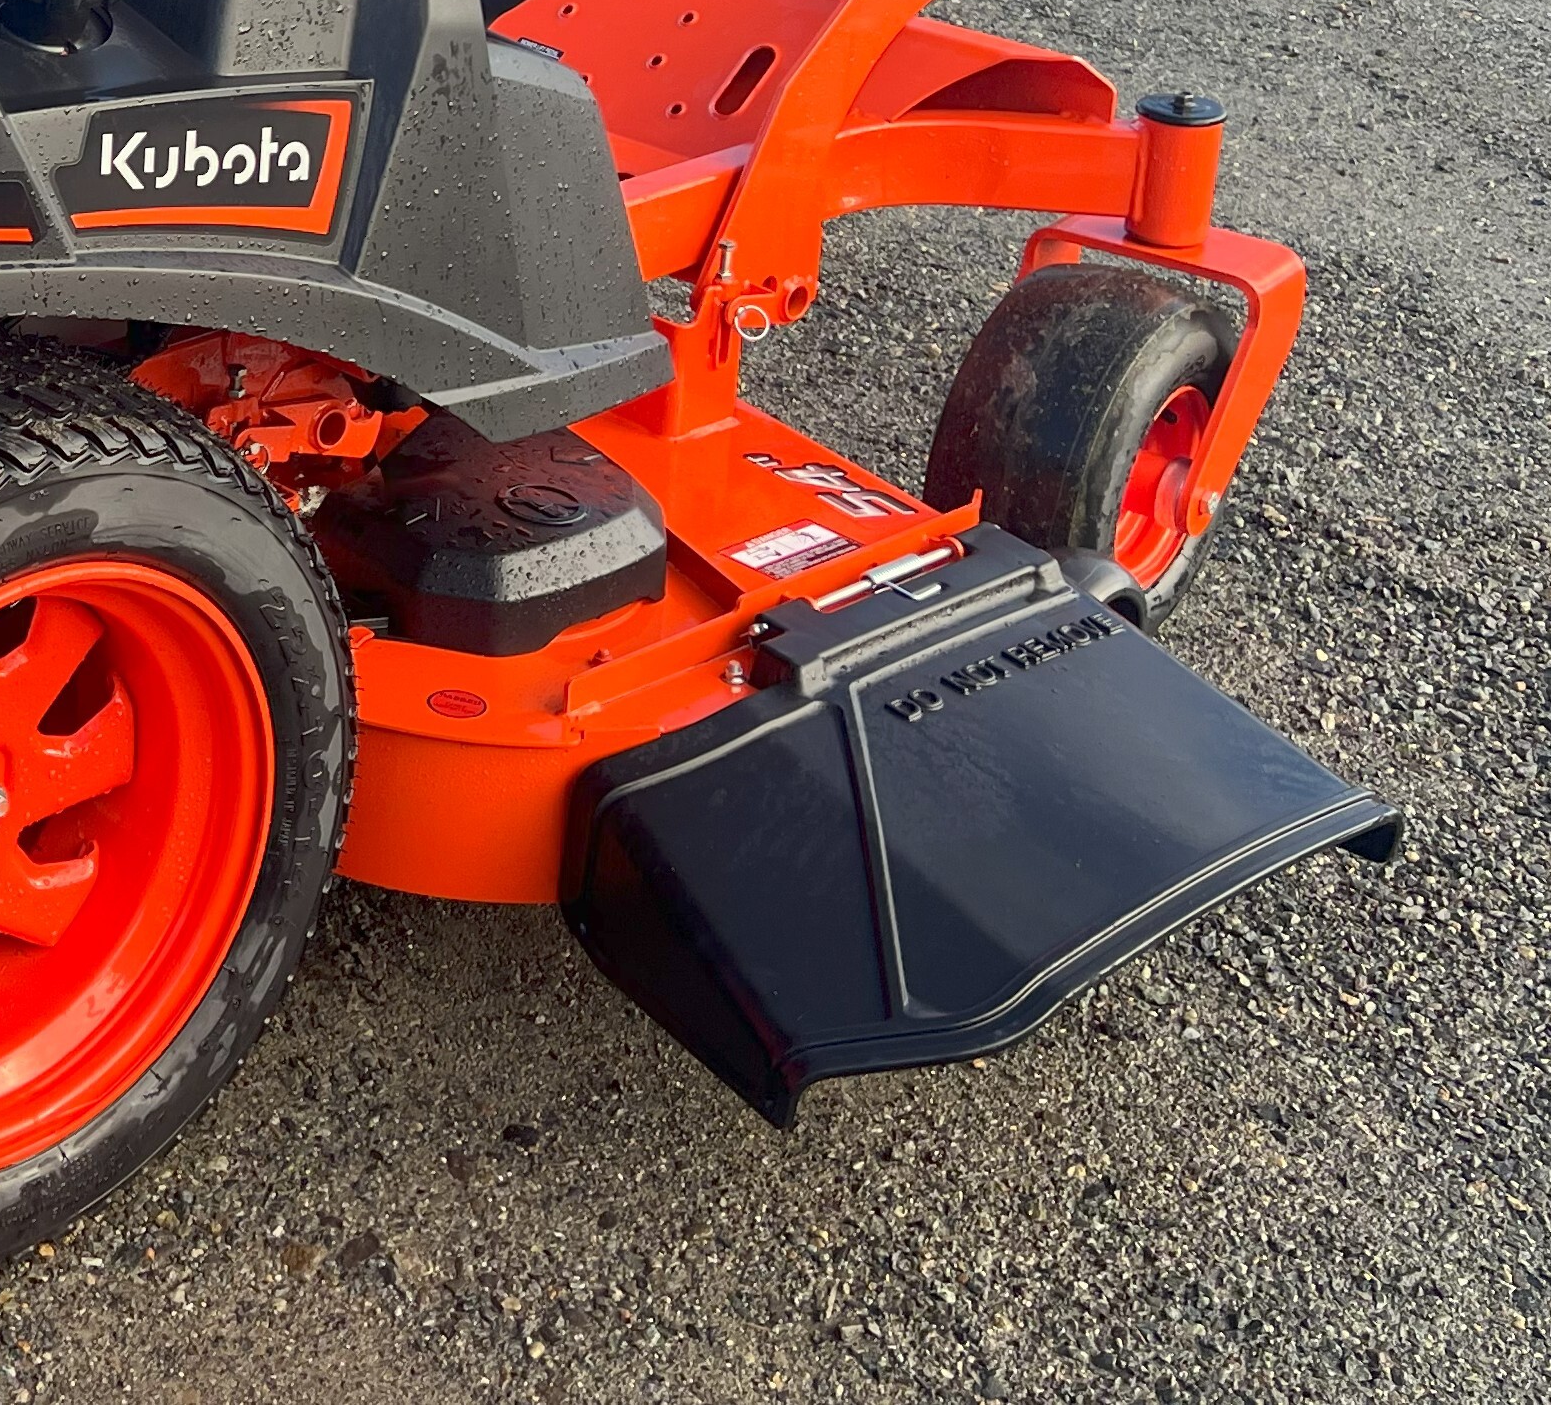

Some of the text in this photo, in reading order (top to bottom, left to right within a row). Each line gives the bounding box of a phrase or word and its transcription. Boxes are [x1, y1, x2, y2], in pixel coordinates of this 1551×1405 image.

[99, 127, 310, 191] Kubota
[40, 516, 90, 540] SERVICE
[884, 612, 1127, 723] DO NOT REMOVE
